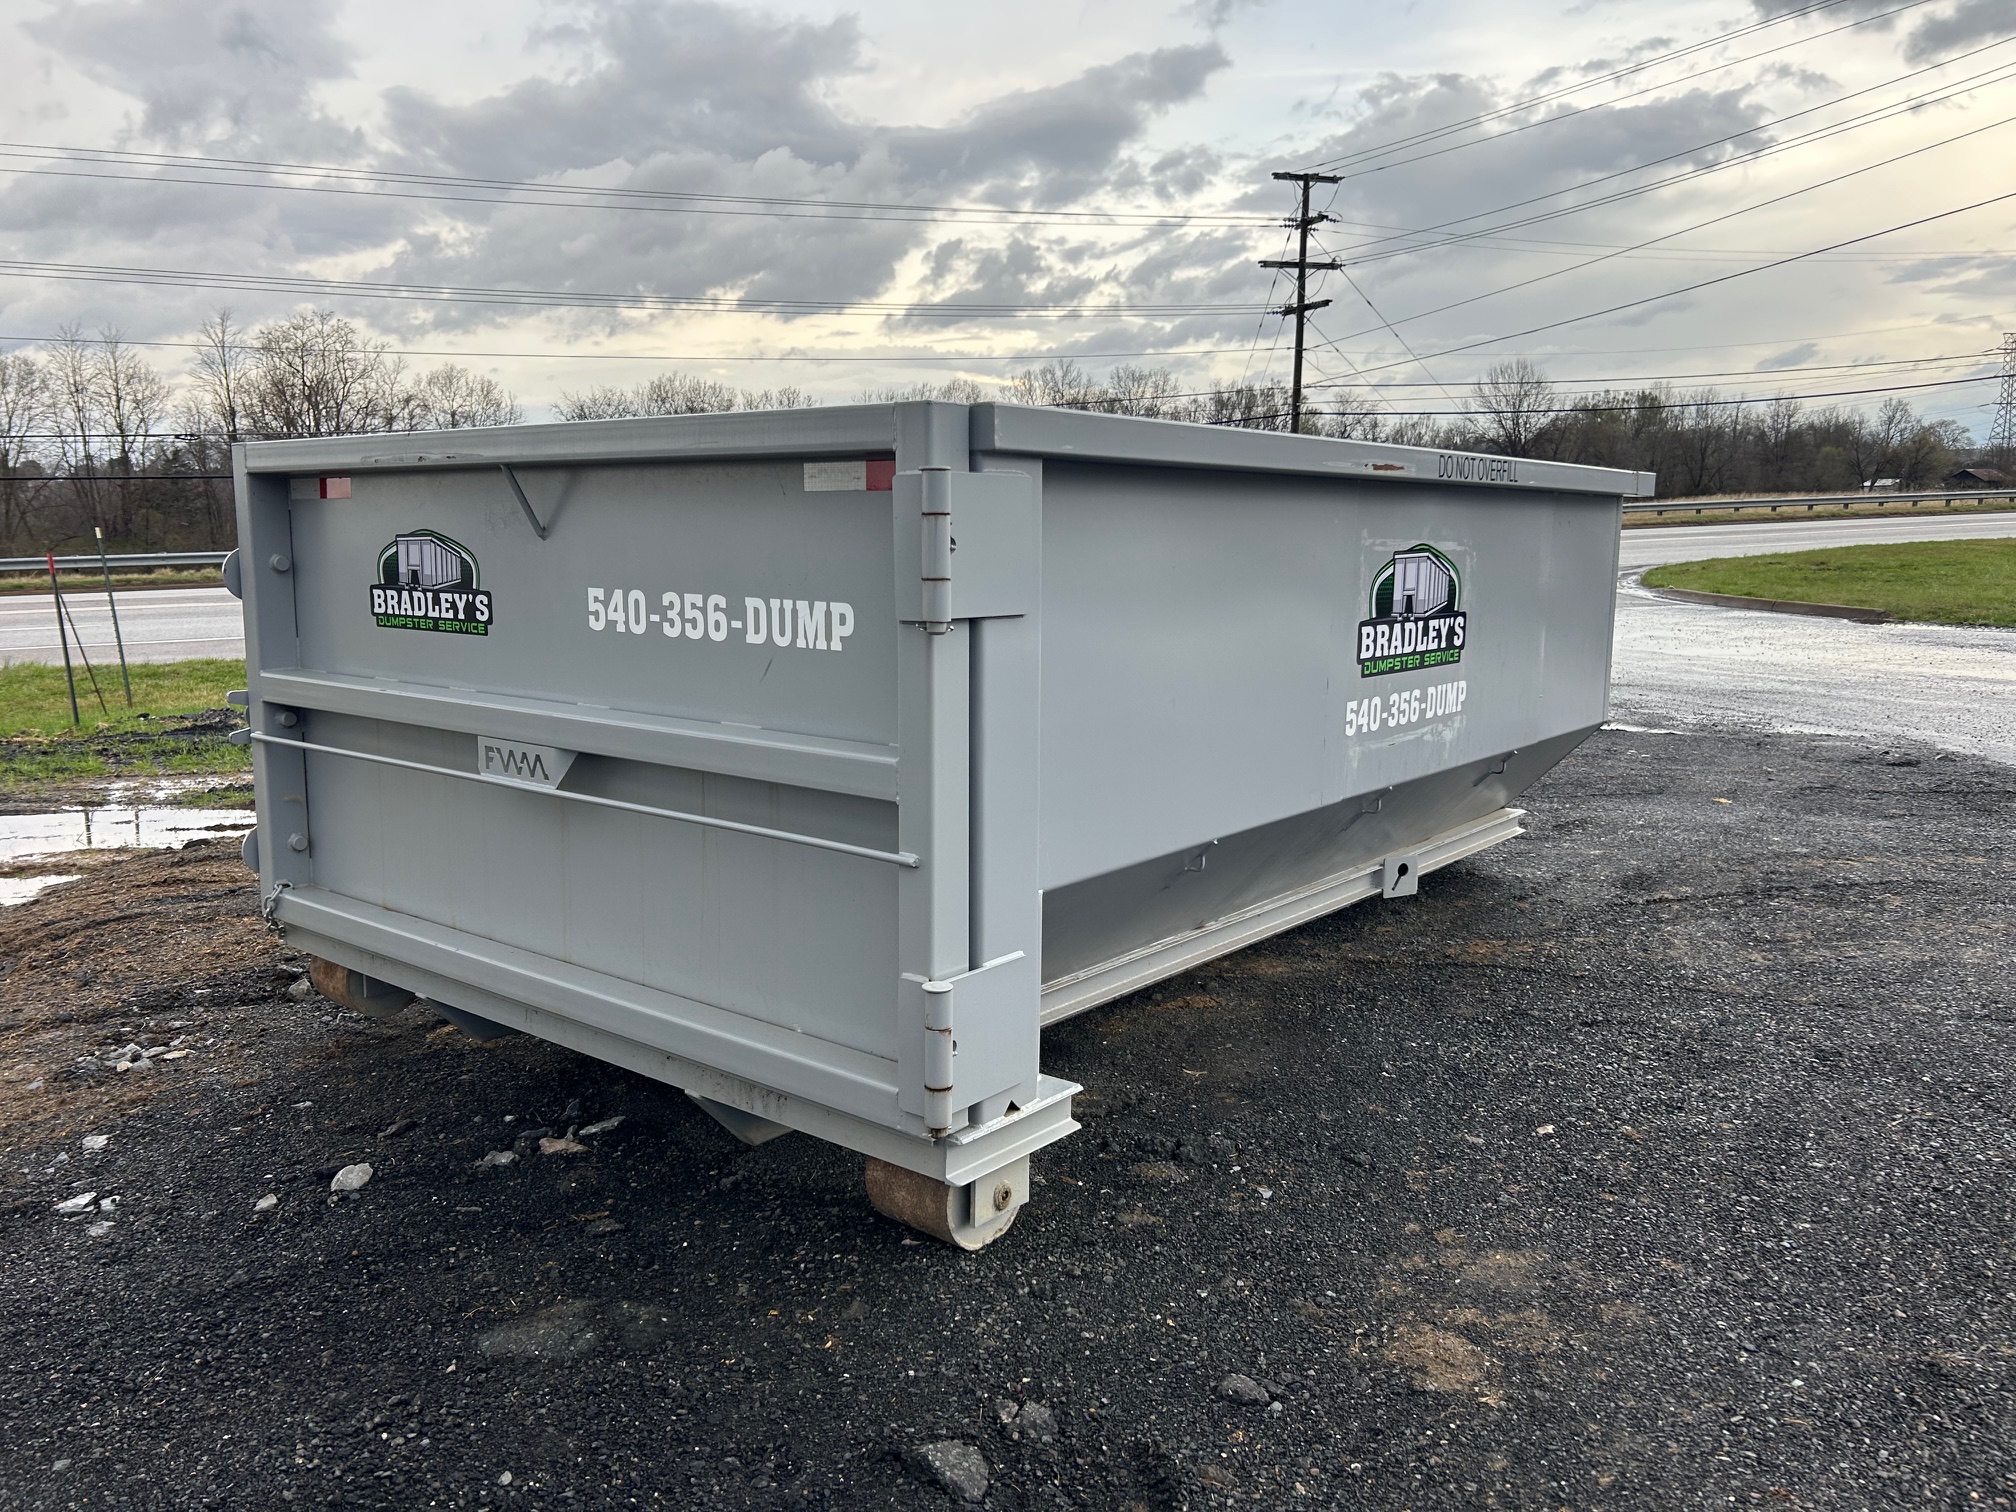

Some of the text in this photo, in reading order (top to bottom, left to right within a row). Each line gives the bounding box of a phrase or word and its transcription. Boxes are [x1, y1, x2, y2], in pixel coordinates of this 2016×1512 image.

[1438, 454, 1519, 483] DO NOT OVERFILL
[372, 588, 490, 622] BRADLEY'S
[587, 587, 855, 652] 540-356-DUMP
[378, 616, 486, 634] DUMPSTER SERVICE
[1360, 616, 1465, 660] BRADLEY'S
[1363, 649, 1460, 675] DUMPSTER SERVICE
[1345, 680, 1467, 737] 540-356-DUMP
[484, 745, 550, 781] FWM
